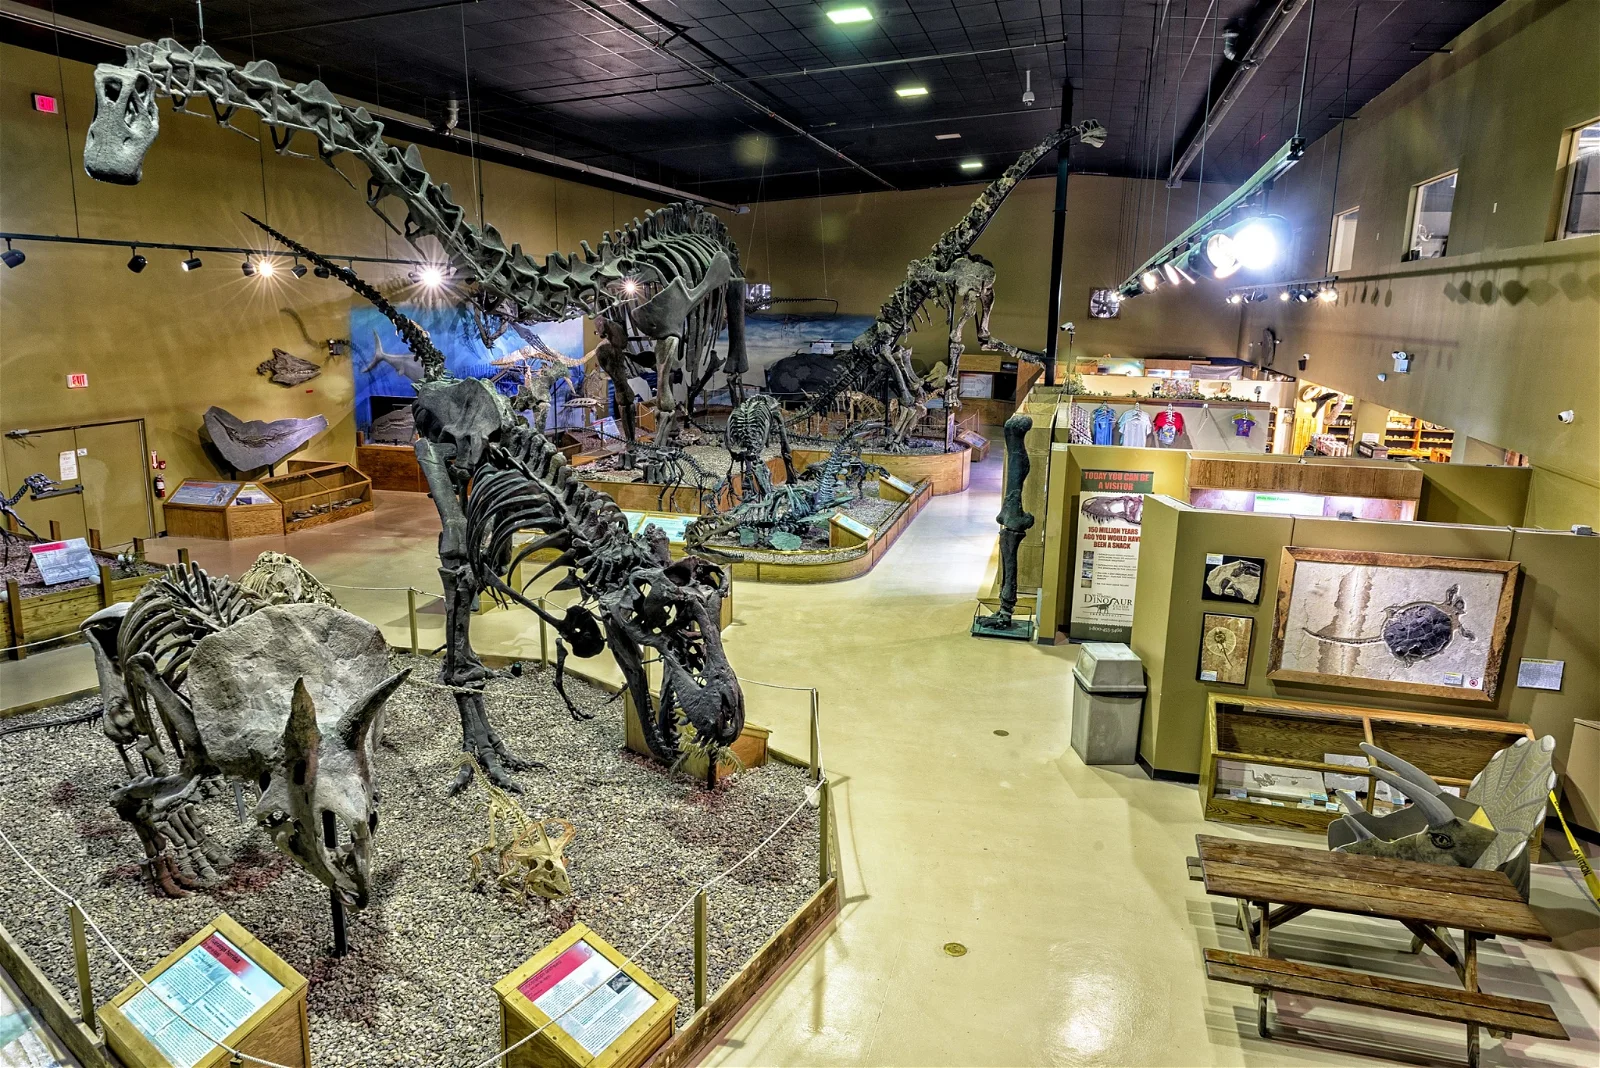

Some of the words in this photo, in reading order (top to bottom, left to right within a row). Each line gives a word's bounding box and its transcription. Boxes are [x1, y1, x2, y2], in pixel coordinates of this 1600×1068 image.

[72, 375, 85, 386] EXIT
[1085, 472, 1107, 480] TODAY
[1109, 472, 1122, 481] YOU
[1124, 473, 1139, 482] CAN
[1140, 473, 1149, 482] BE
[1105, 482, 1134, 491] VISITOR
[1573, 849, 1592, 877] CAUTION
